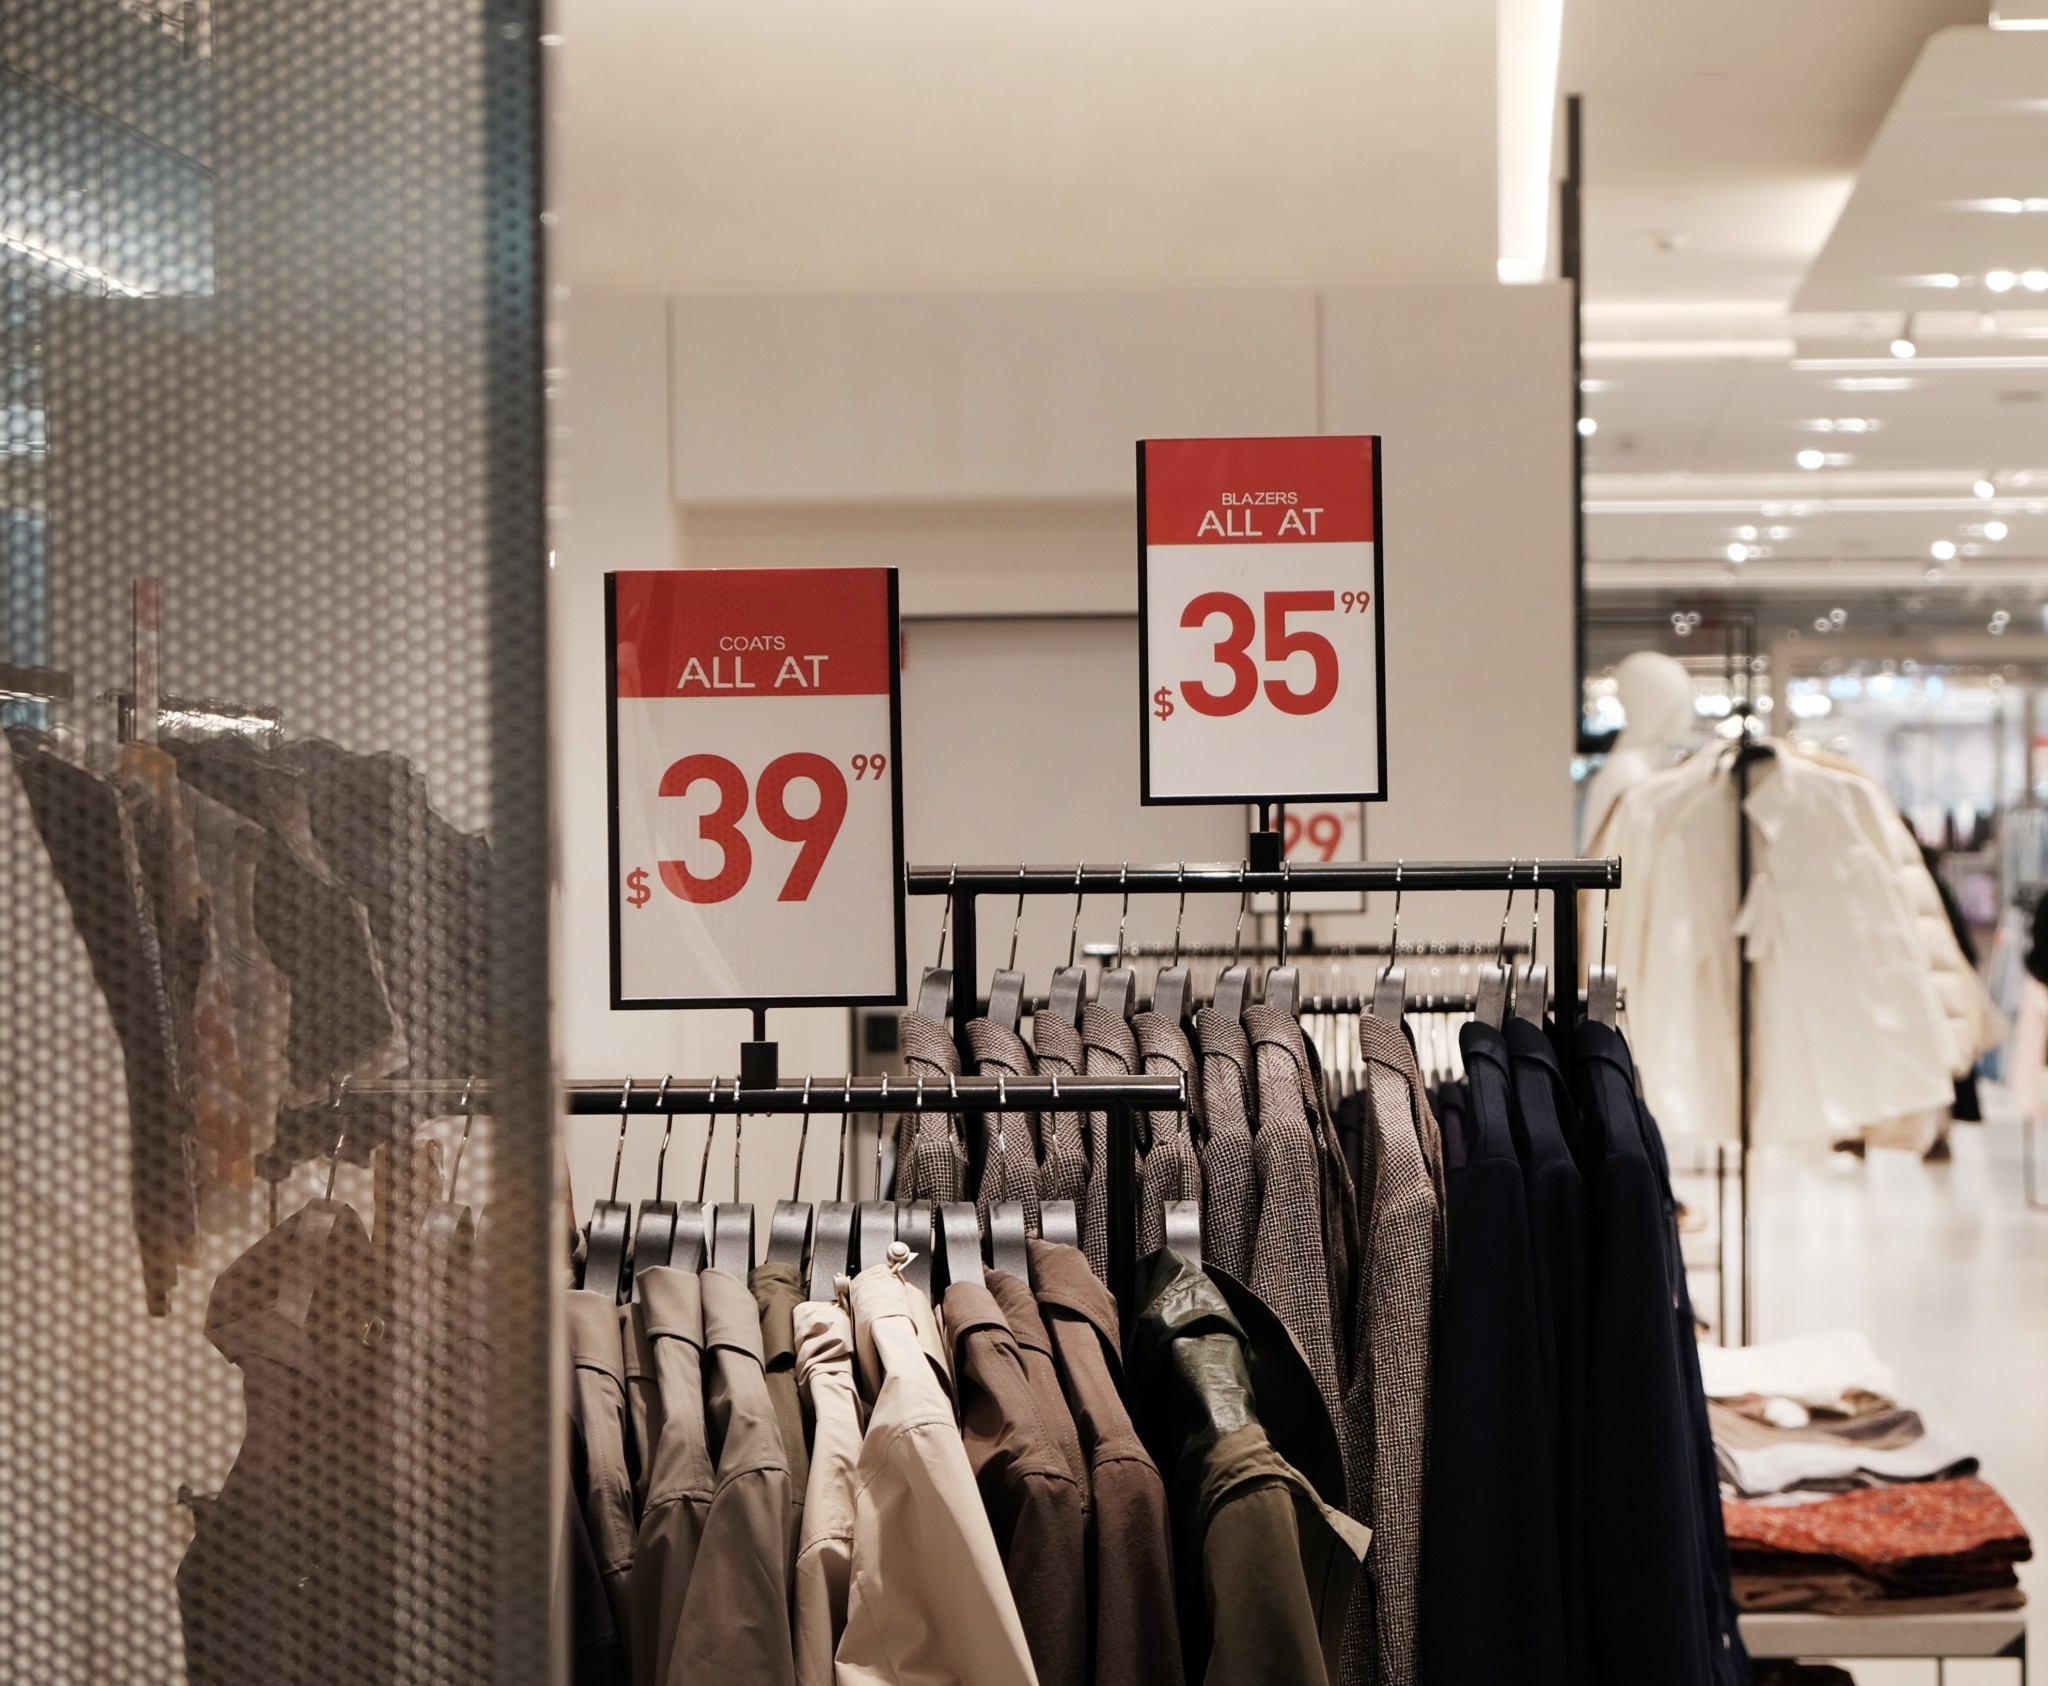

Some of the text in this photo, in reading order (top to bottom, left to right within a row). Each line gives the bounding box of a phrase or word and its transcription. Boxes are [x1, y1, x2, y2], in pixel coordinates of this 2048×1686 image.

[1221, 491, 1298, 506] BLAZERS
[1196, 507, 1324, 537] ALL AT
[719, 635, 786, 651] COATS
[1179, 590, 1340, 718] 35
[1340, 591, 1371, 614] 99
[677, 654, 829, 689] ALL AT
[658, 751, 849, 905] 39
[851, 754, 886, 781] 99
